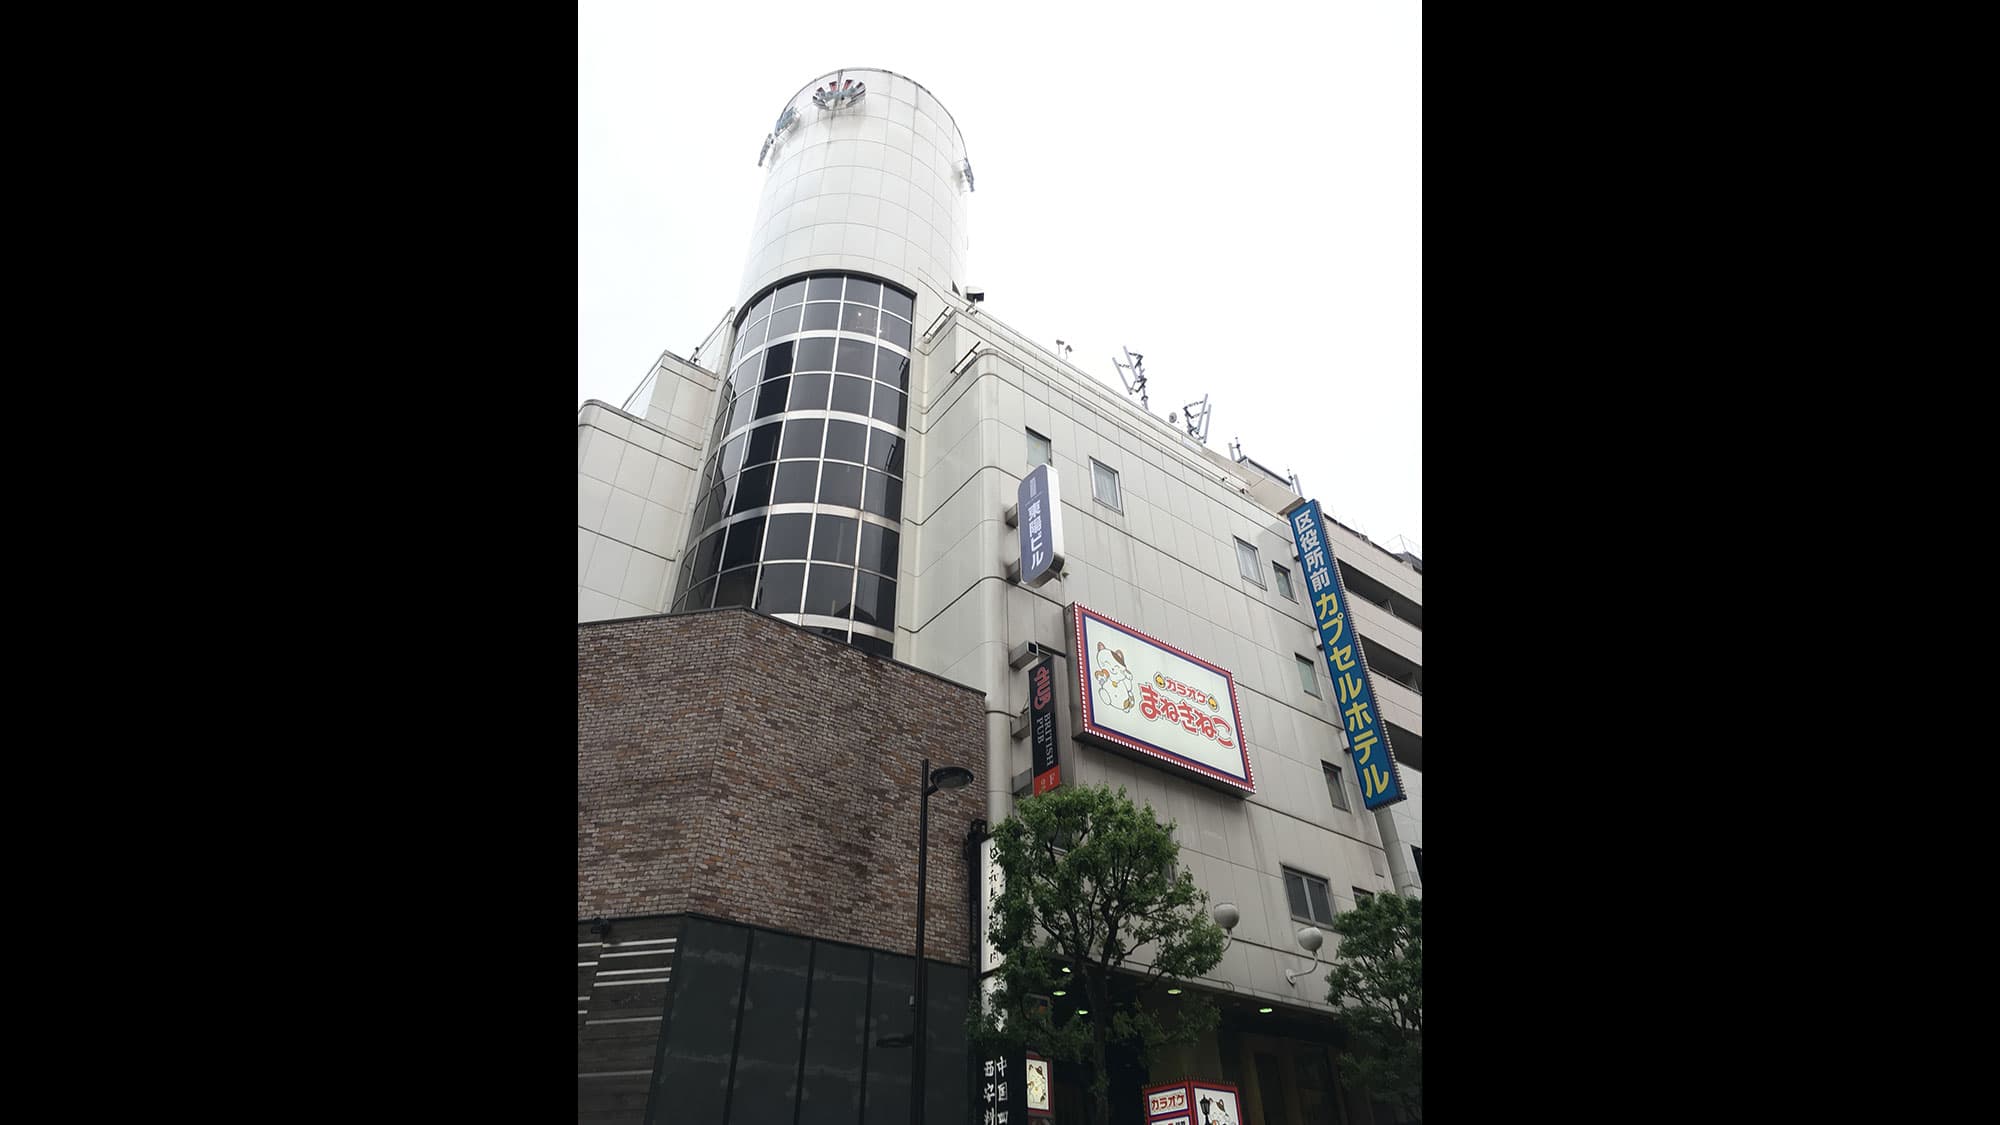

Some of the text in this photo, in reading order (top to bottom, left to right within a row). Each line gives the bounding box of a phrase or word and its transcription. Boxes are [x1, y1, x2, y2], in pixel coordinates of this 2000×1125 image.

[1295, 509, 1389, 799] 区役所前 カプセルホテル
[1034, 666, 1051, 710] HUB
[1165, 679, 1207, 704] カラオケ
[1036, 716, 1044, 744] PUB
[1140, 684, 1234, 747] まねきねこ
[1044, 712, 1054, 767] BRITISH
[1151, 1094, 1185, 1111] カラオケ
